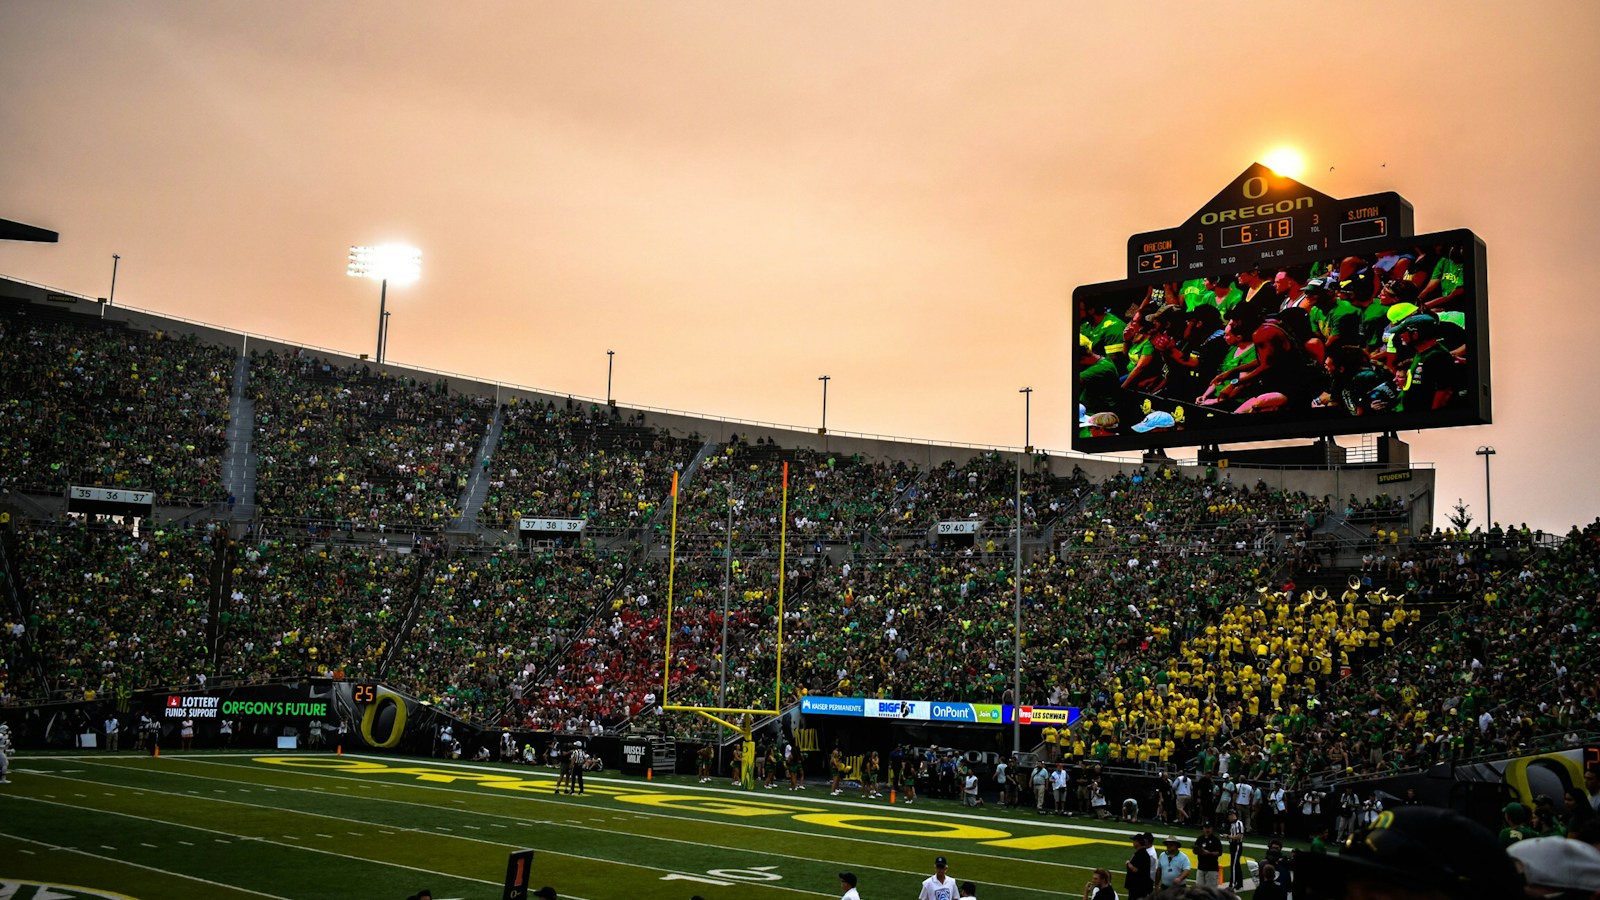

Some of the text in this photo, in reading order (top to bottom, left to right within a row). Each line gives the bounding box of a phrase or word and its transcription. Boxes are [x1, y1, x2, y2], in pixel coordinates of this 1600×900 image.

[1242, 176, 1269, 199] O
[1347, 206, 1379, 220] S.UTAH
[1312, 214, 1319, 225] 3
[1241, 219, 1289, 243] 6:18
[1374, 220, 1384, 233] 7
[1197, 233, 1204, 244] 3
[1143, 240, 1172, 253] OREGON
[1379, 471, 1410, 482] STUDENTS
[79, 489, 144, 502] 35 36 37
[525, 520, 577, 530] 37 38 39
[940, 524, 951, 532] 39
[954, 524, 965, 532] 40
[355, 685, 374, 702] 25
[182, 696, 220, 708] LOTTERY
[812, 702, 828, 711] KAISER
[165, 706, 218, 718] FUNDS SUPPORT
[222, 701, 327, 716] OREGON'S FUTURE
[932, 705, 969, 719] OnPoint
[360, 692, 407, 748] O
[1032, 711, 1066, 720] LES SCHWAB
[623, 745, 646, 755] MUSCLE
[626, 754, 641, 764] MILK
[513, 857, 525, 887] 1
